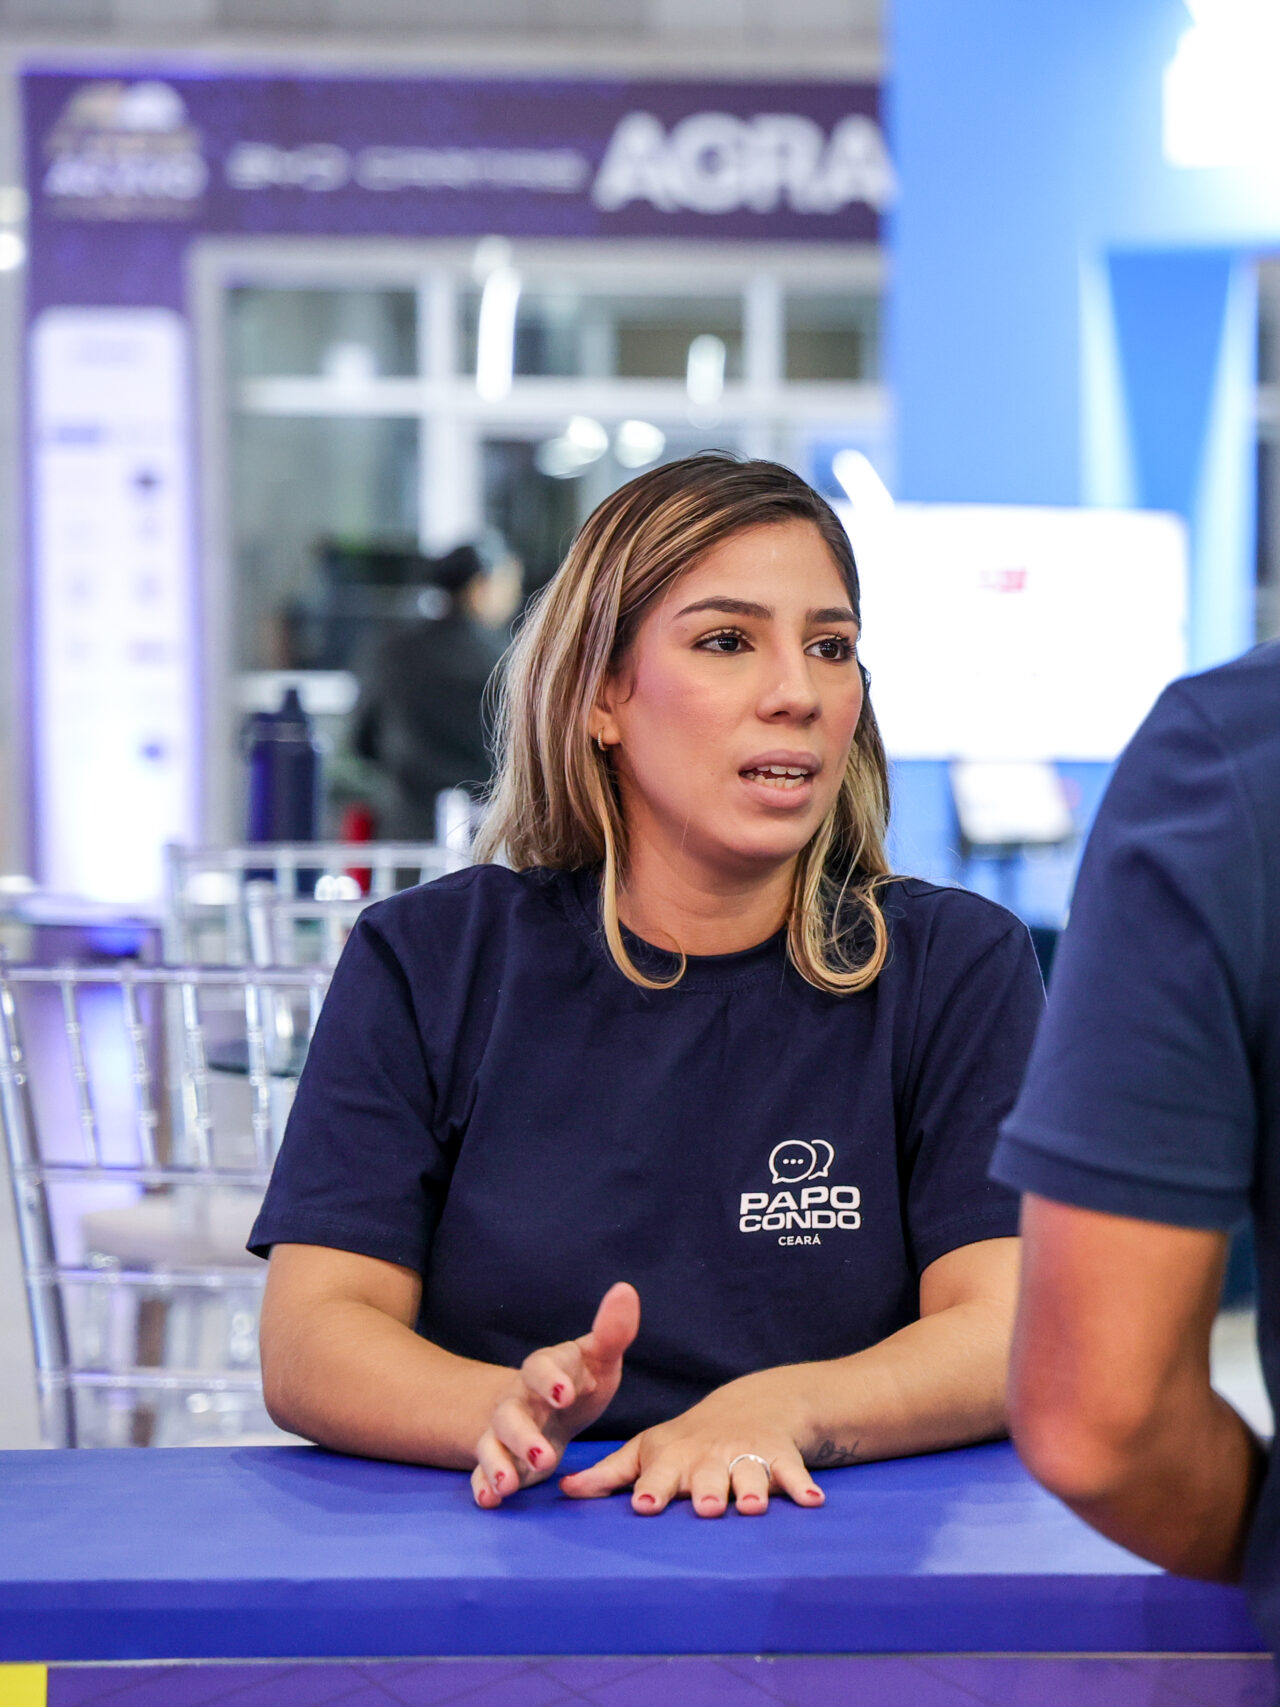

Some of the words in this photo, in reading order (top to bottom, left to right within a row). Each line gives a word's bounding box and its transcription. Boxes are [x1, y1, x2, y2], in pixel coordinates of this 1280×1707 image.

[739, 1185, 861, 1215] PAPO
[739, 1210, 862, 1233] CONDO
[778, 1233, 822, 1246] CEARÁ
